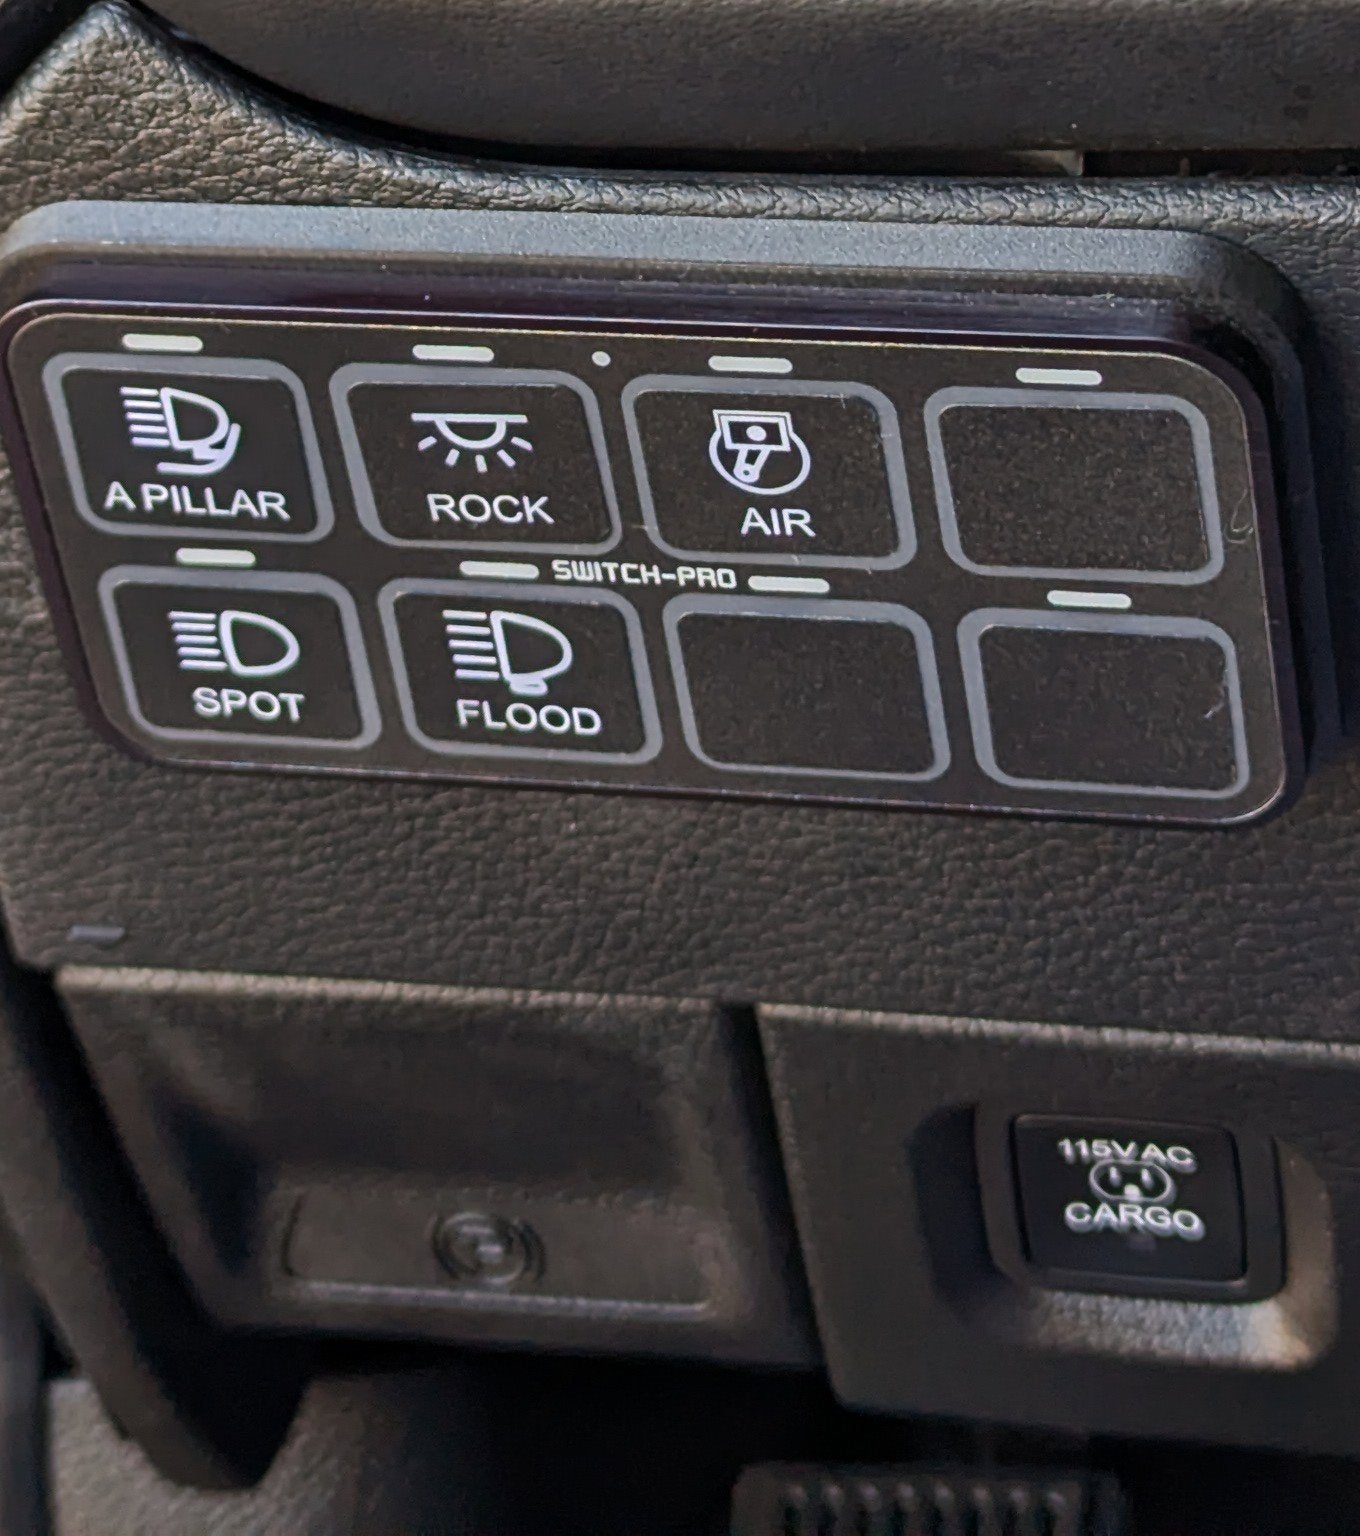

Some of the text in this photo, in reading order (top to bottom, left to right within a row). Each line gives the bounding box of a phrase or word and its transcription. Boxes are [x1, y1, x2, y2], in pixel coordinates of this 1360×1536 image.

[103, 479, 292, 522] A PILLAR
[425, 492, 556, 526] ROCK
[739, 506, 818, 539] AIR
[191, 685, 306, 723] SPOT
[455, 696, 604, 737] FLOOD
[1064, 1201, 1206, 1242] CARGO
